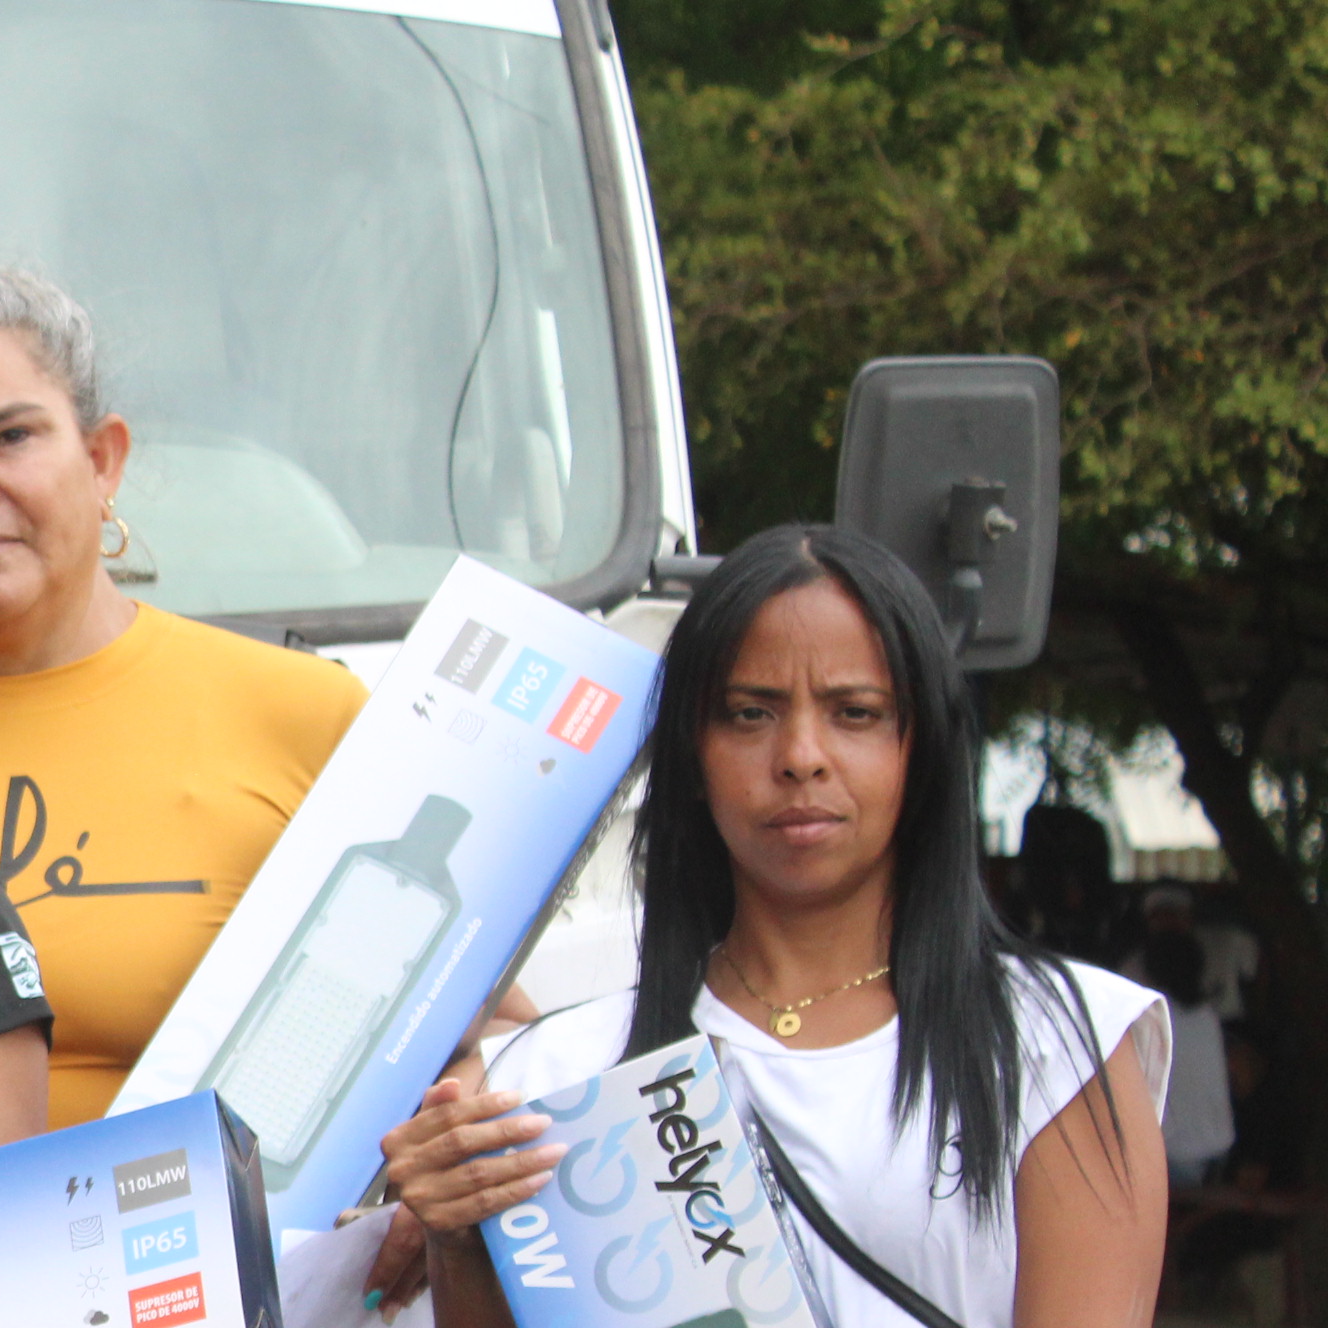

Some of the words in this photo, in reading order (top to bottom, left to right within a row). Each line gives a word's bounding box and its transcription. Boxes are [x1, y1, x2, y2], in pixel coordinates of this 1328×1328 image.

[507, 661, 548, 711] IP65
[385, 1001, 432, 1065] Encendido
[427, 917, 482, 1001] automatizado
[118, 1165, 187, 1197] 110LMW
[638, 1067, 746, 1264] helyox
[132, 1226, 187, 1260] IP65
[135, 1288, 184, 1313] SUPRESOR
[185, 1285, 199, 1299] DE
[136, 1307, 157, 1323] PICO
[158, 1305, 171, 1318] DE
[171, 1298, 200, 1315] 4000V
